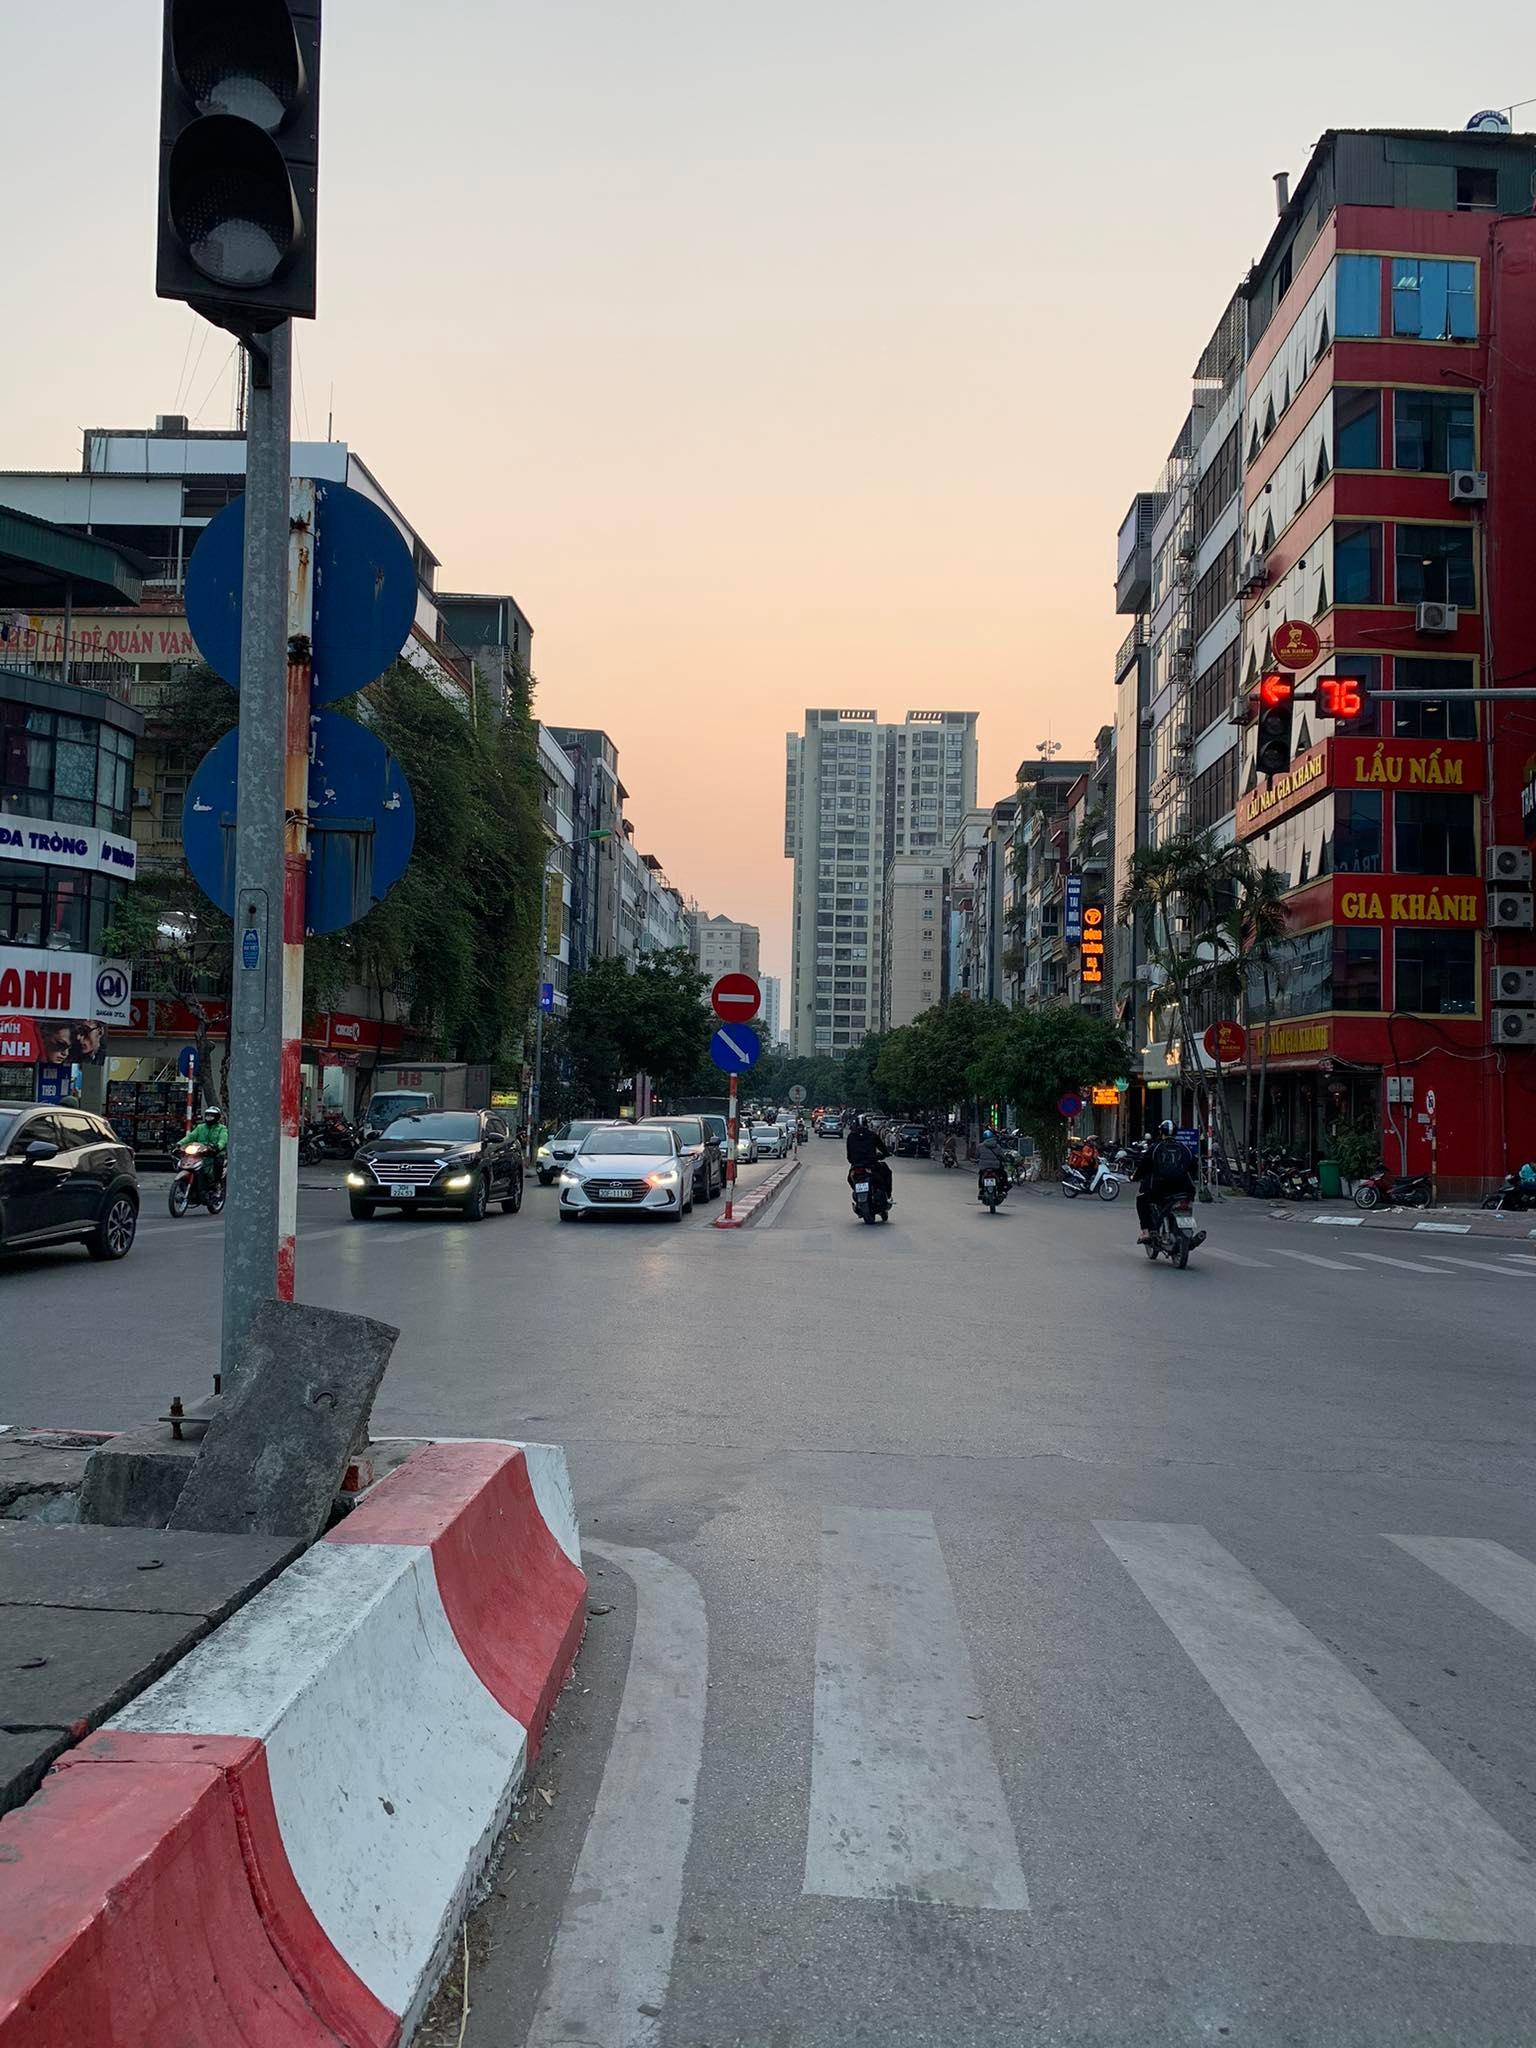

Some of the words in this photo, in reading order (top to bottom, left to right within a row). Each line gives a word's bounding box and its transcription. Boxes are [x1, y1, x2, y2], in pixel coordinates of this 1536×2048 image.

[80, 625, 103, 653] DÊ
[106, 625, 154, 655] QUÁN
[1320, 681, 1361, 716] 76
[1277, 775, 1291, 803] GIA
[1291, 755, 1323, 793] KHÁNH
[1355, 743, 1404, 783] LẨU
[1408, 748, 1464, 785] NẤM
[29, 832, 88, 856] TRÒNG
[1341, 892, 1385, 919] GIA
[1391, 886, 1477, 921] KHÁNH
[0, 968, 72, 1010] ANH
[0, 1040, 31, 1057] NH
[397, 1071, 422, 1086] HB
